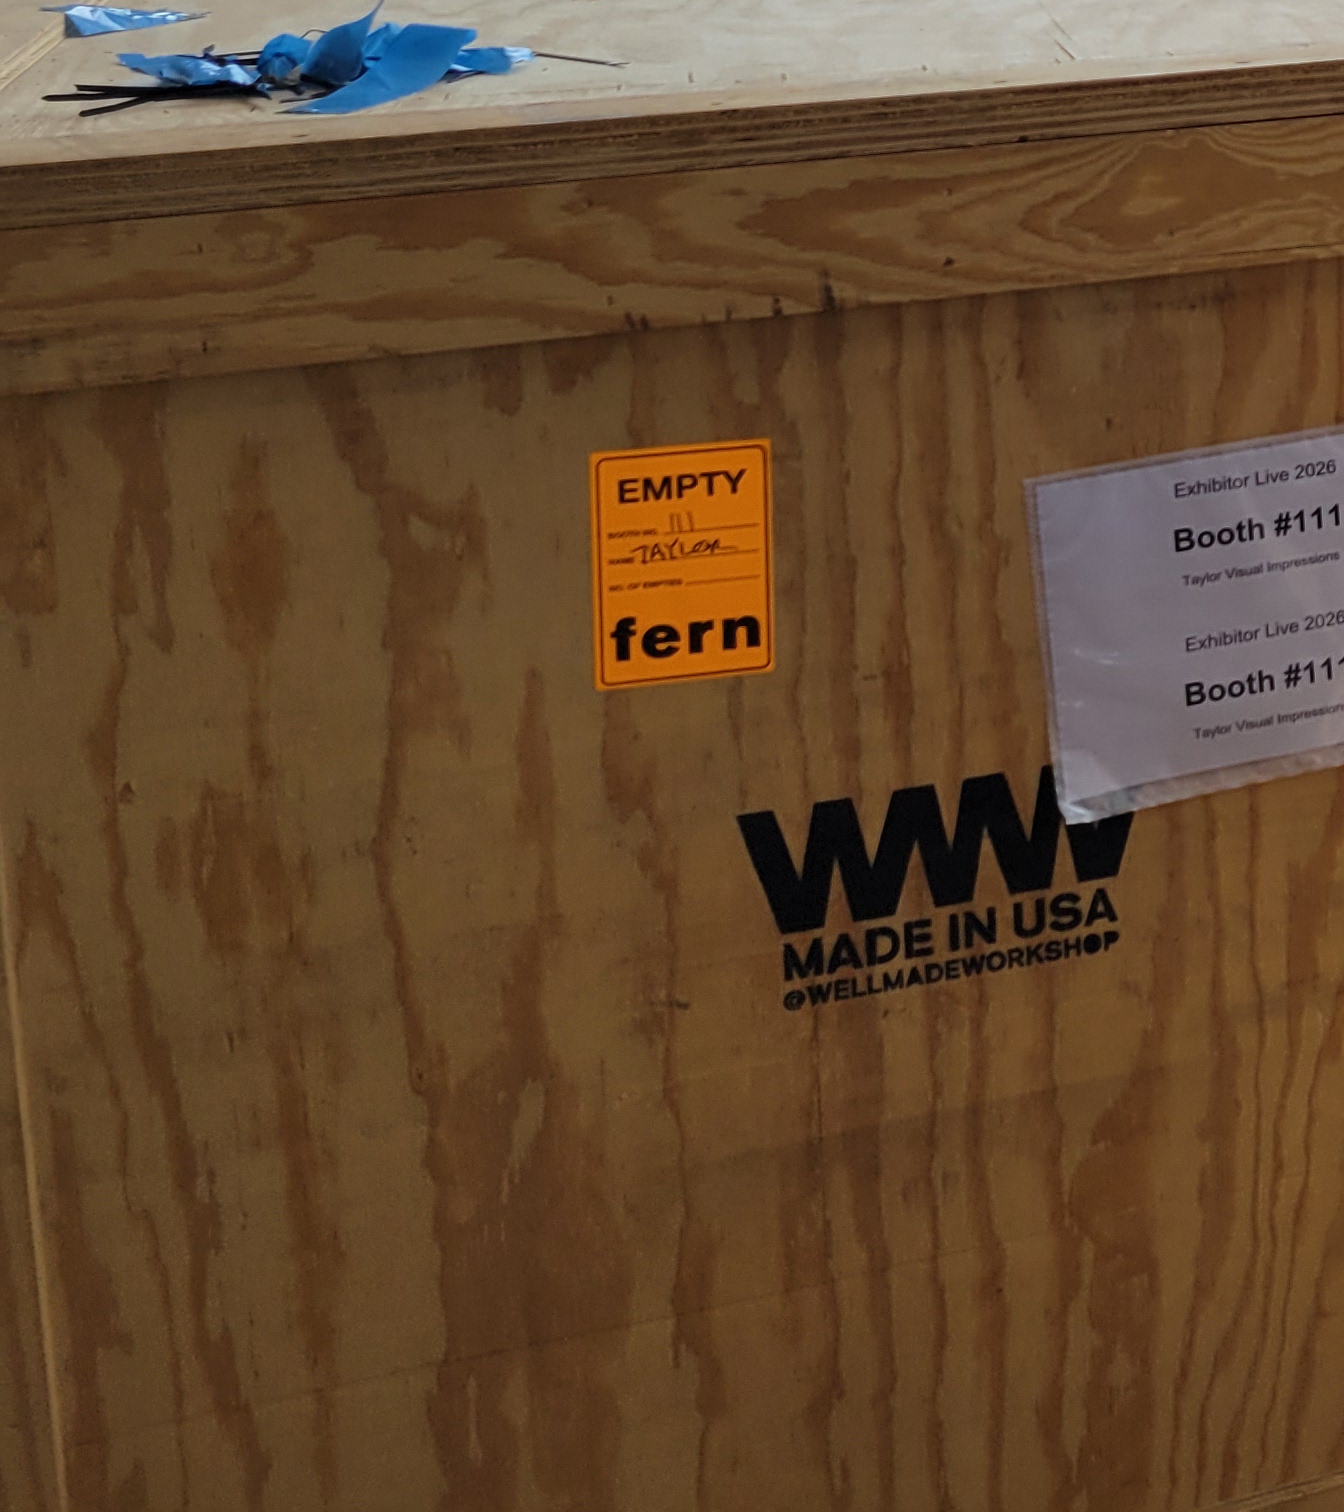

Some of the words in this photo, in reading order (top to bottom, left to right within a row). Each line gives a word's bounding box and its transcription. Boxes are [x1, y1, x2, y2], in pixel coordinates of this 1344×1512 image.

[618, 468, 748, 504] EMPTY
[1174, 475, 1250, 499] Exhibitor
[1255, 469, 1289, 486] Live
[1295, 459, 1337, 480] 2026
[1174, 517, 1265, 553] Booth
[1274, 503, 1341, 537] #111
[630, 538, 738, 565] TAYLOR
[1182, 571, 1221, 587] Taylor
[1225, 562, 1264, 579] Visual
[1267, 551, 1341, 573] Impressions
[610, 615, 761, 662] fern
[1186, 628, 1260, 653] Exhibitor
[1265, 621, 1299, 638] Live
[1185, 670, 1275, 707] Booth
[1194, 724, 1232, 740] Taylor
[1235, 714, 1274, 732] Visual
[783, 919, 934, 982] MADE
[948, 906, 997, 952] IN
[1013, 888, 1119, 938] USA
[783, 930, 1120, 1012] @WELLMADEWORKSHOP
